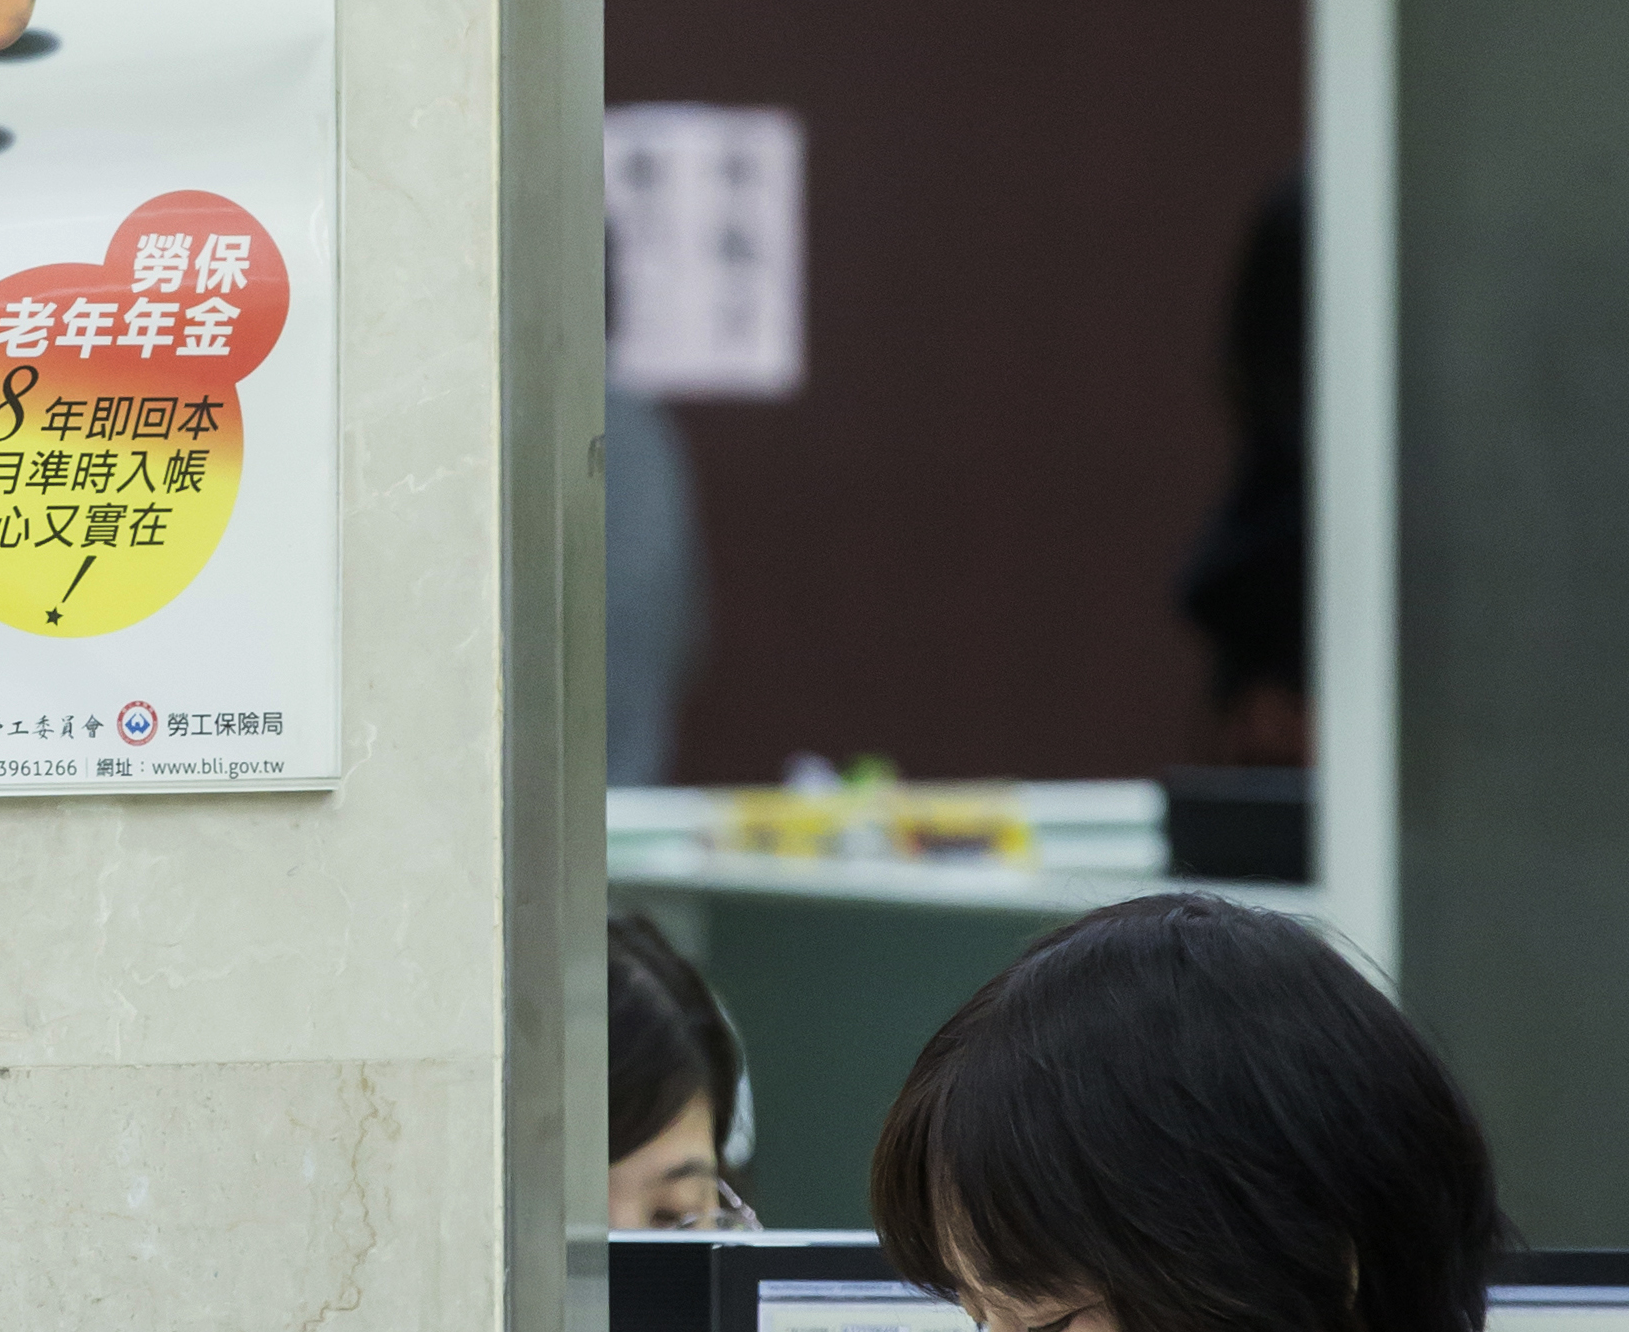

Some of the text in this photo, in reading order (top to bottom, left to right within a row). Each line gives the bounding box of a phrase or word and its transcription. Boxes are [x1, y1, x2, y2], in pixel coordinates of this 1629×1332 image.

[131, 233, 251, 294] 勞保
[166, 711, 284, 738] 勞工保險局
